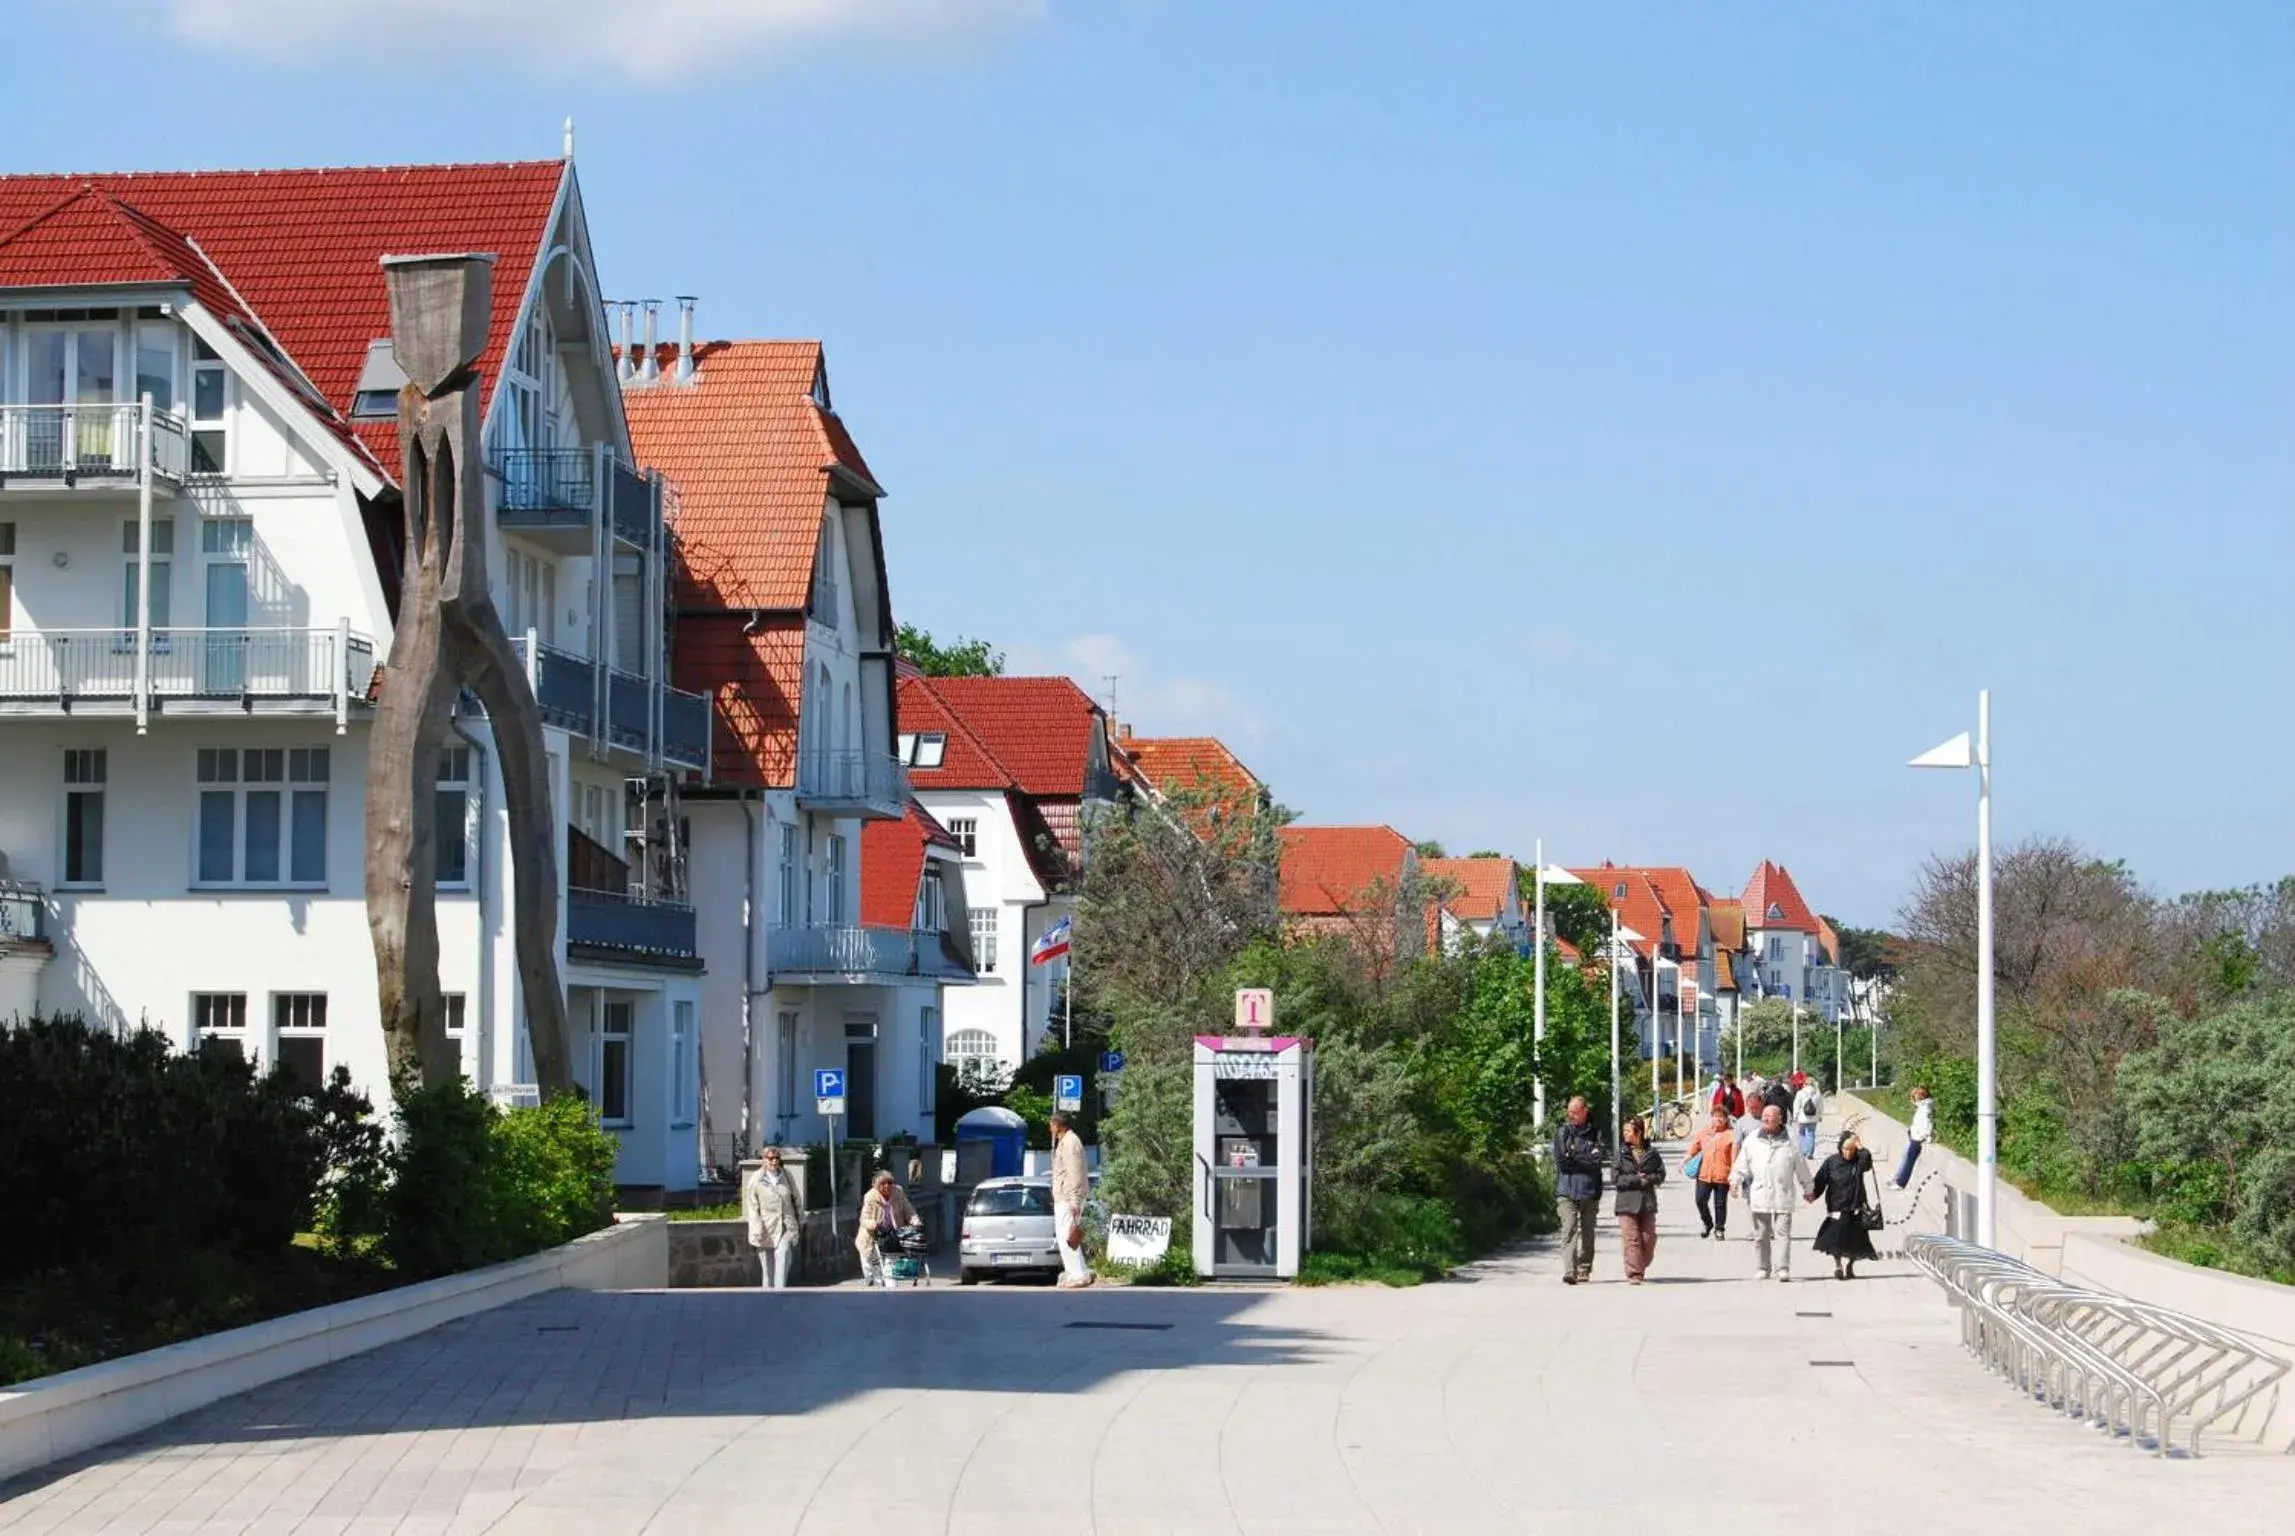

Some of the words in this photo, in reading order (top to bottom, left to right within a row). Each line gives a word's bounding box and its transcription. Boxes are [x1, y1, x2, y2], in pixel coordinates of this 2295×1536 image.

[1241, 991, 1267, 1024] T
[1108, 1053, 1121, 1071] P
[821, 1072, 838, 1095] P
[1062, 1078, 1075, 1096] P
[1111, 1218, 1169, 1236] FAHRRAD
